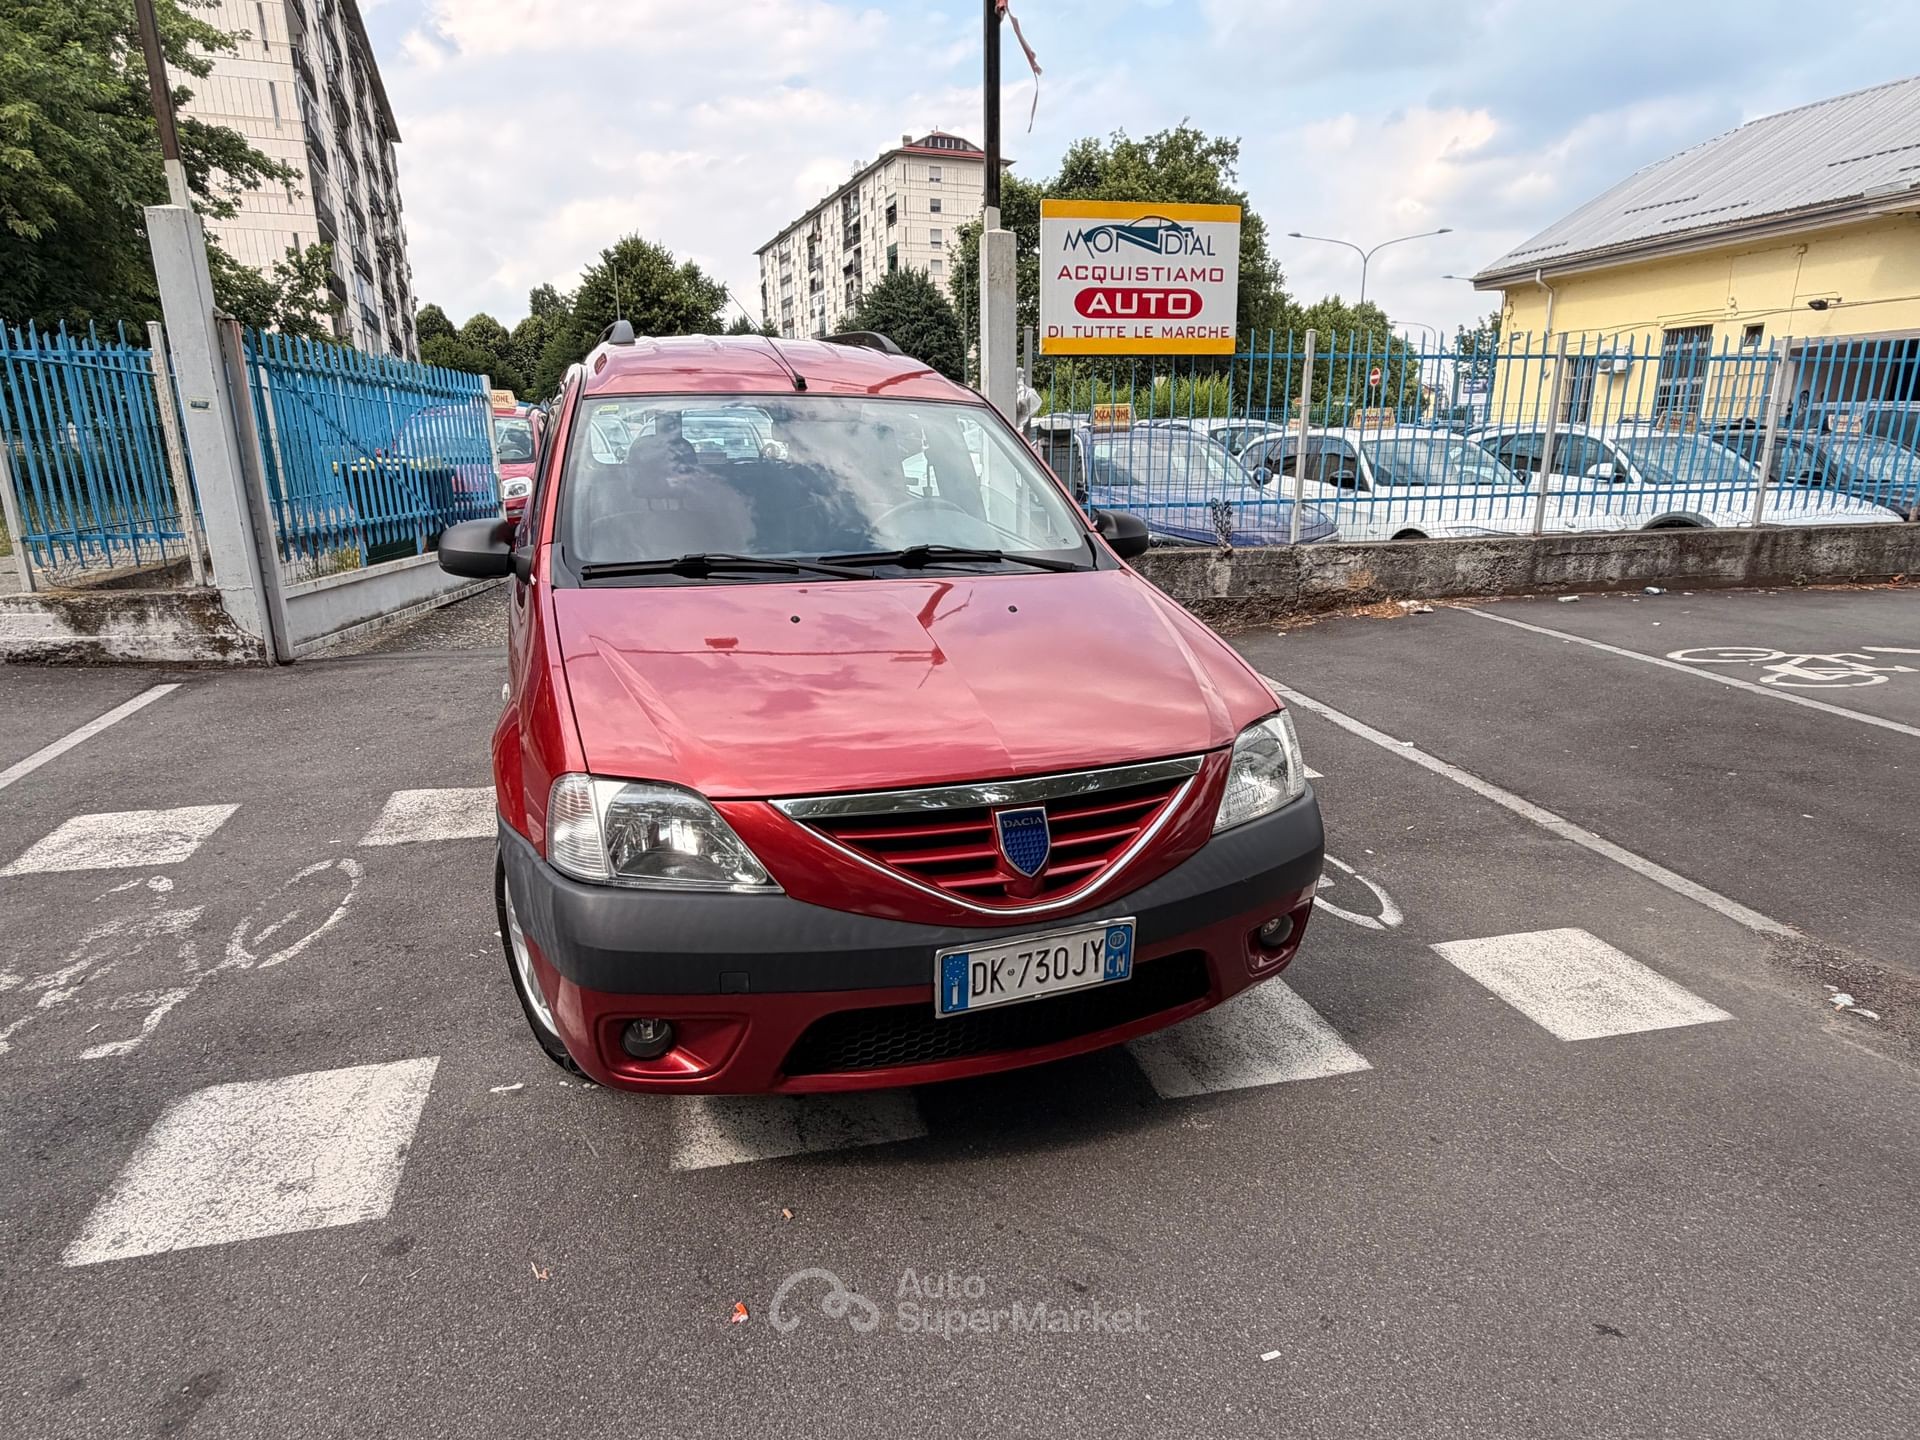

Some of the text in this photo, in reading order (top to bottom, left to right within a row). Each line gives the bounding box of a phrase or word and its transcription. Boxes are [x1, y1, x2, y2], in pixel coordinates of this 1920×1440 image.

[1057, 265, 1224, 283] ACQUISTIAMO
[1086, 292, 1192, 315] AUTO
[1048, 325, 1230, 338] DI TUTTE LE MARCHE
[1094, 409, 1130, 420] OCCAIONE
[1003, 817, 1043, 828] DACIA
[1106, 953, 1126, 974] CN
